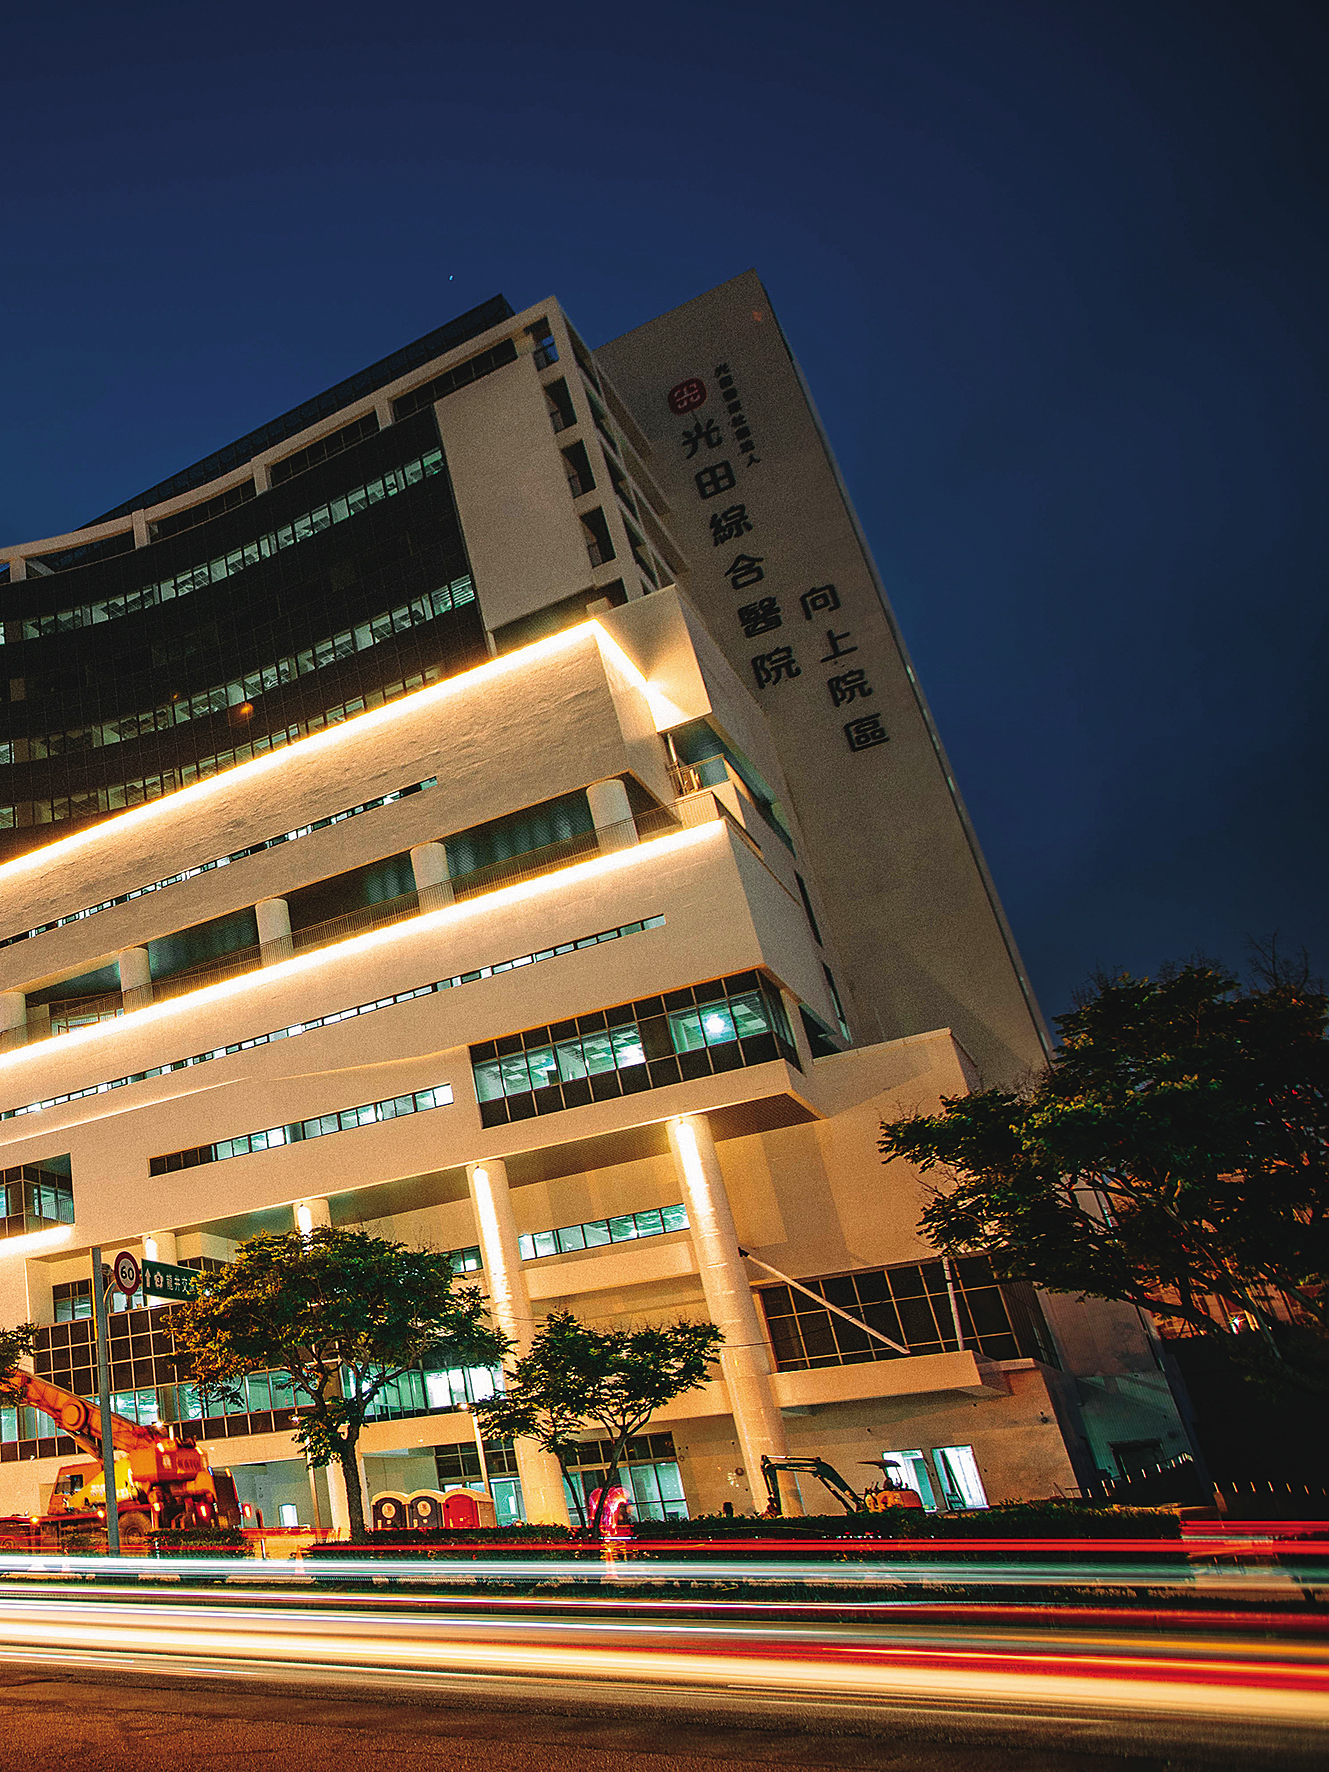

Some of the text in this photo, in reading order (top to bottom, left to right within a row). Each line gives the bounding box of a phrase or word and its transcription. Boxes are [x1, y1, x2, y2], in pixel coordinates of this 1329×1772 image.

[681, 411, 801, 690] 光田綜合醫院
[799, 583, 890, 752] 向上院區
[120, 1265, 135, 1281] 60
